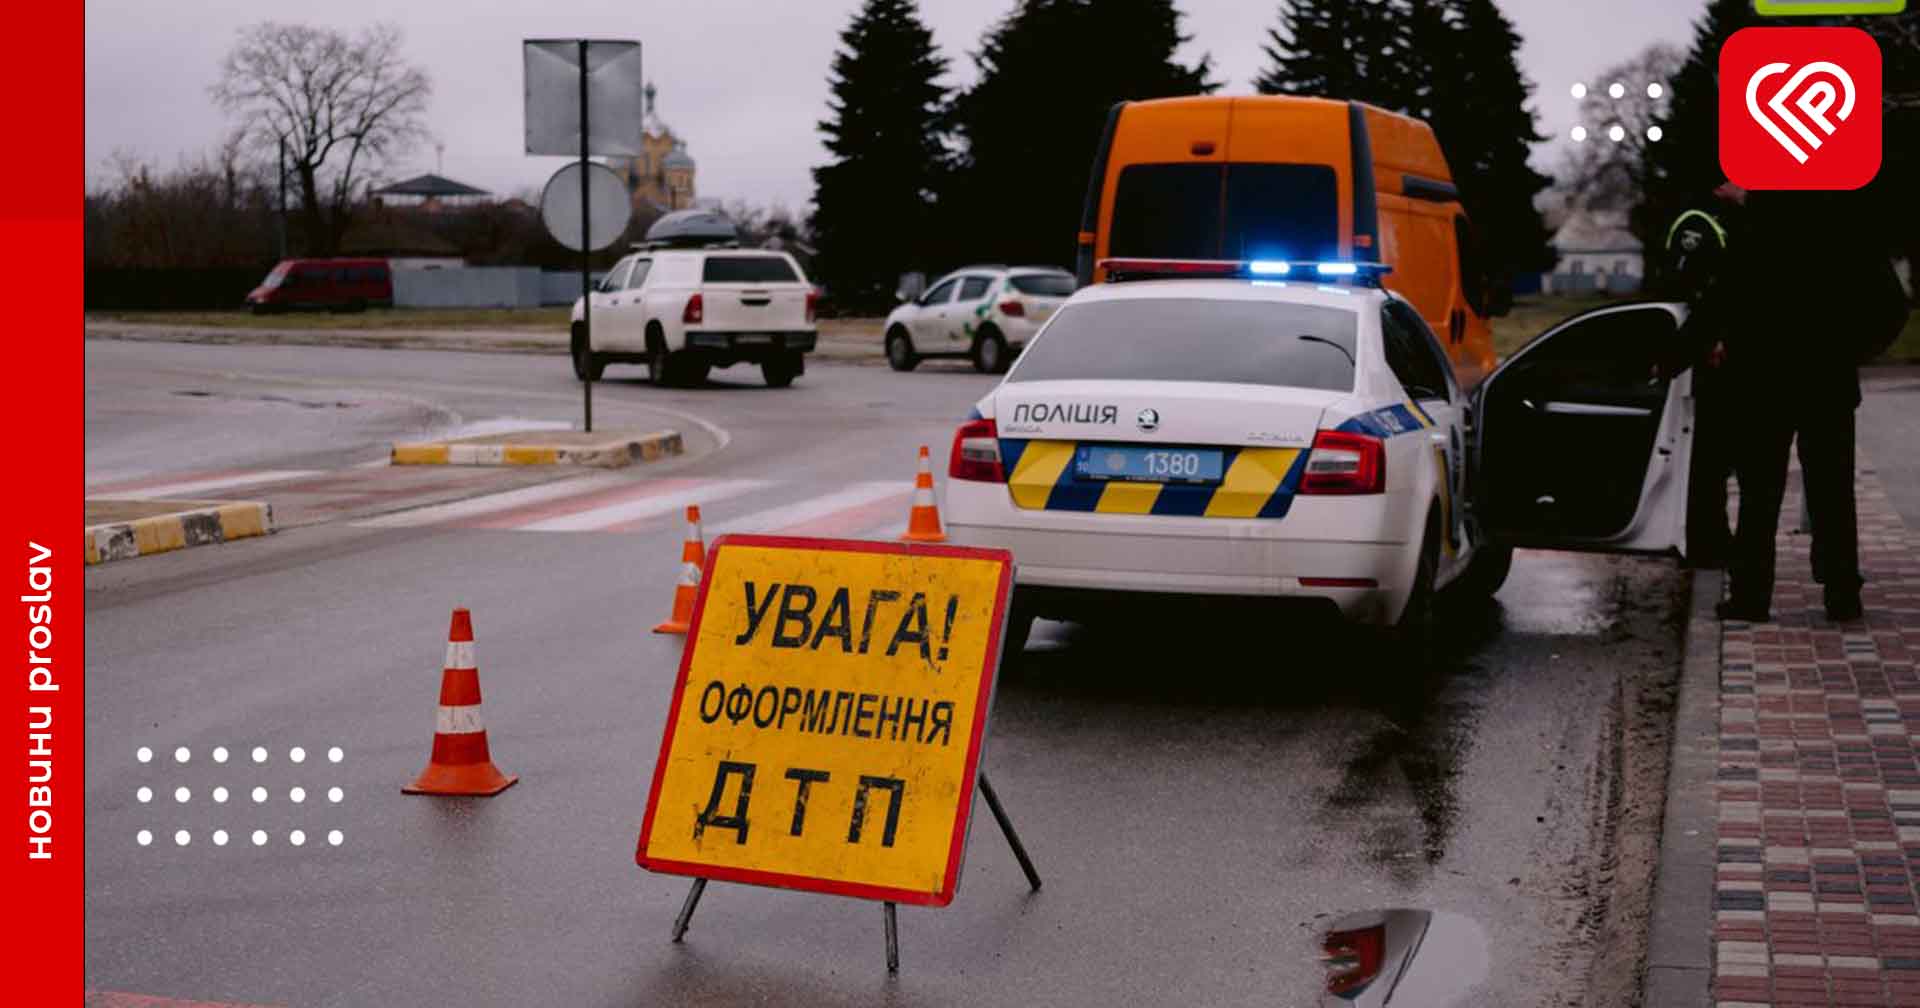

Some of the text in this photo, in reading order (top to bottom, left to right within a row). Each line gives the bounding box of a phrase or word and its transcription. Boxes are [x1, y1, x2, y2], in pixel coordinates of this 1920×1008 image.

[1013, 403, 1118, 425] ПОЛІЦІЯ
[1143, 452, 1200, 475] 1380
[735, 581, 960, 663] УВАГА!
[699, 680, 955, 746] ОФОРМЛЕННЯ
